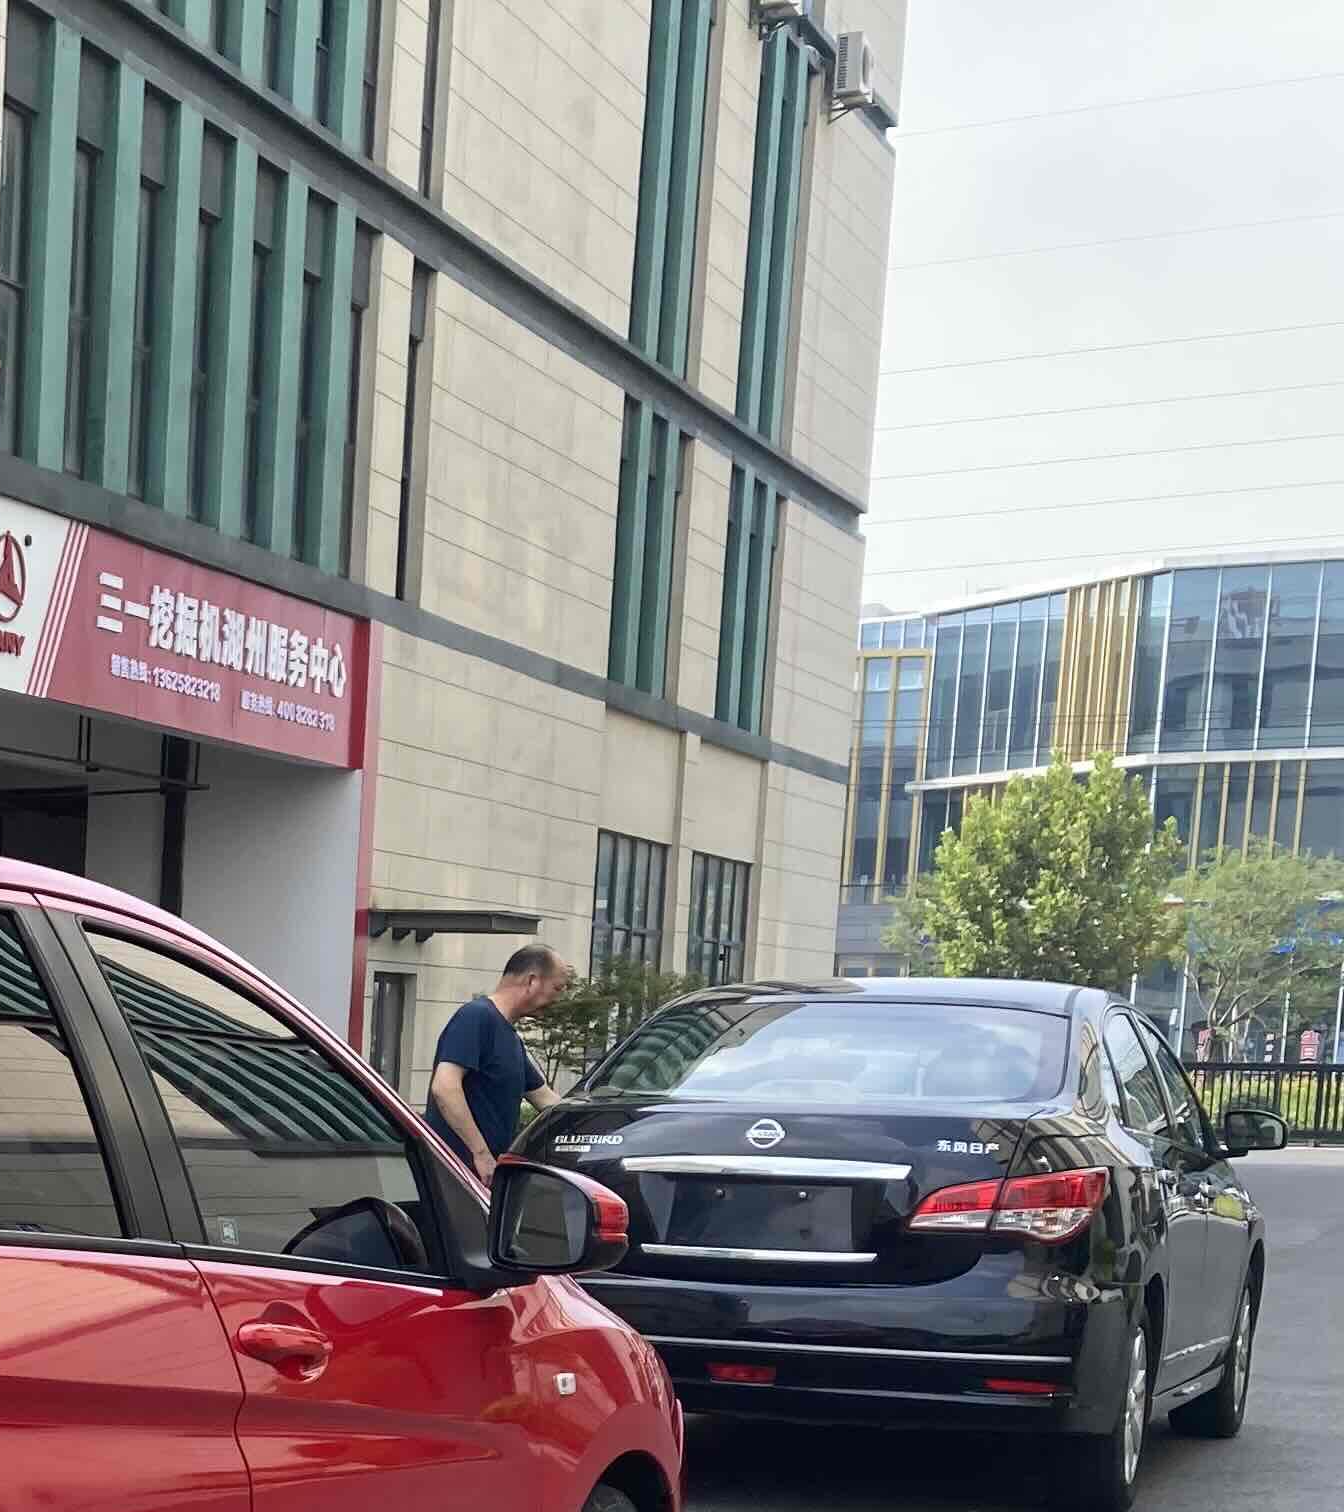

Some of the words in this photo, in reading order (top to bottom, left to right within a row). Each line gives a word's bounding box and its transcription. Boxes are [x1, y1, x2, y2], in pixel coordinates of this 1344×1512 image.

[96, 572, 348, 698] 三一挖掘机湖州服务中心
[936, 1139, 1000, 1154] 东风日产
